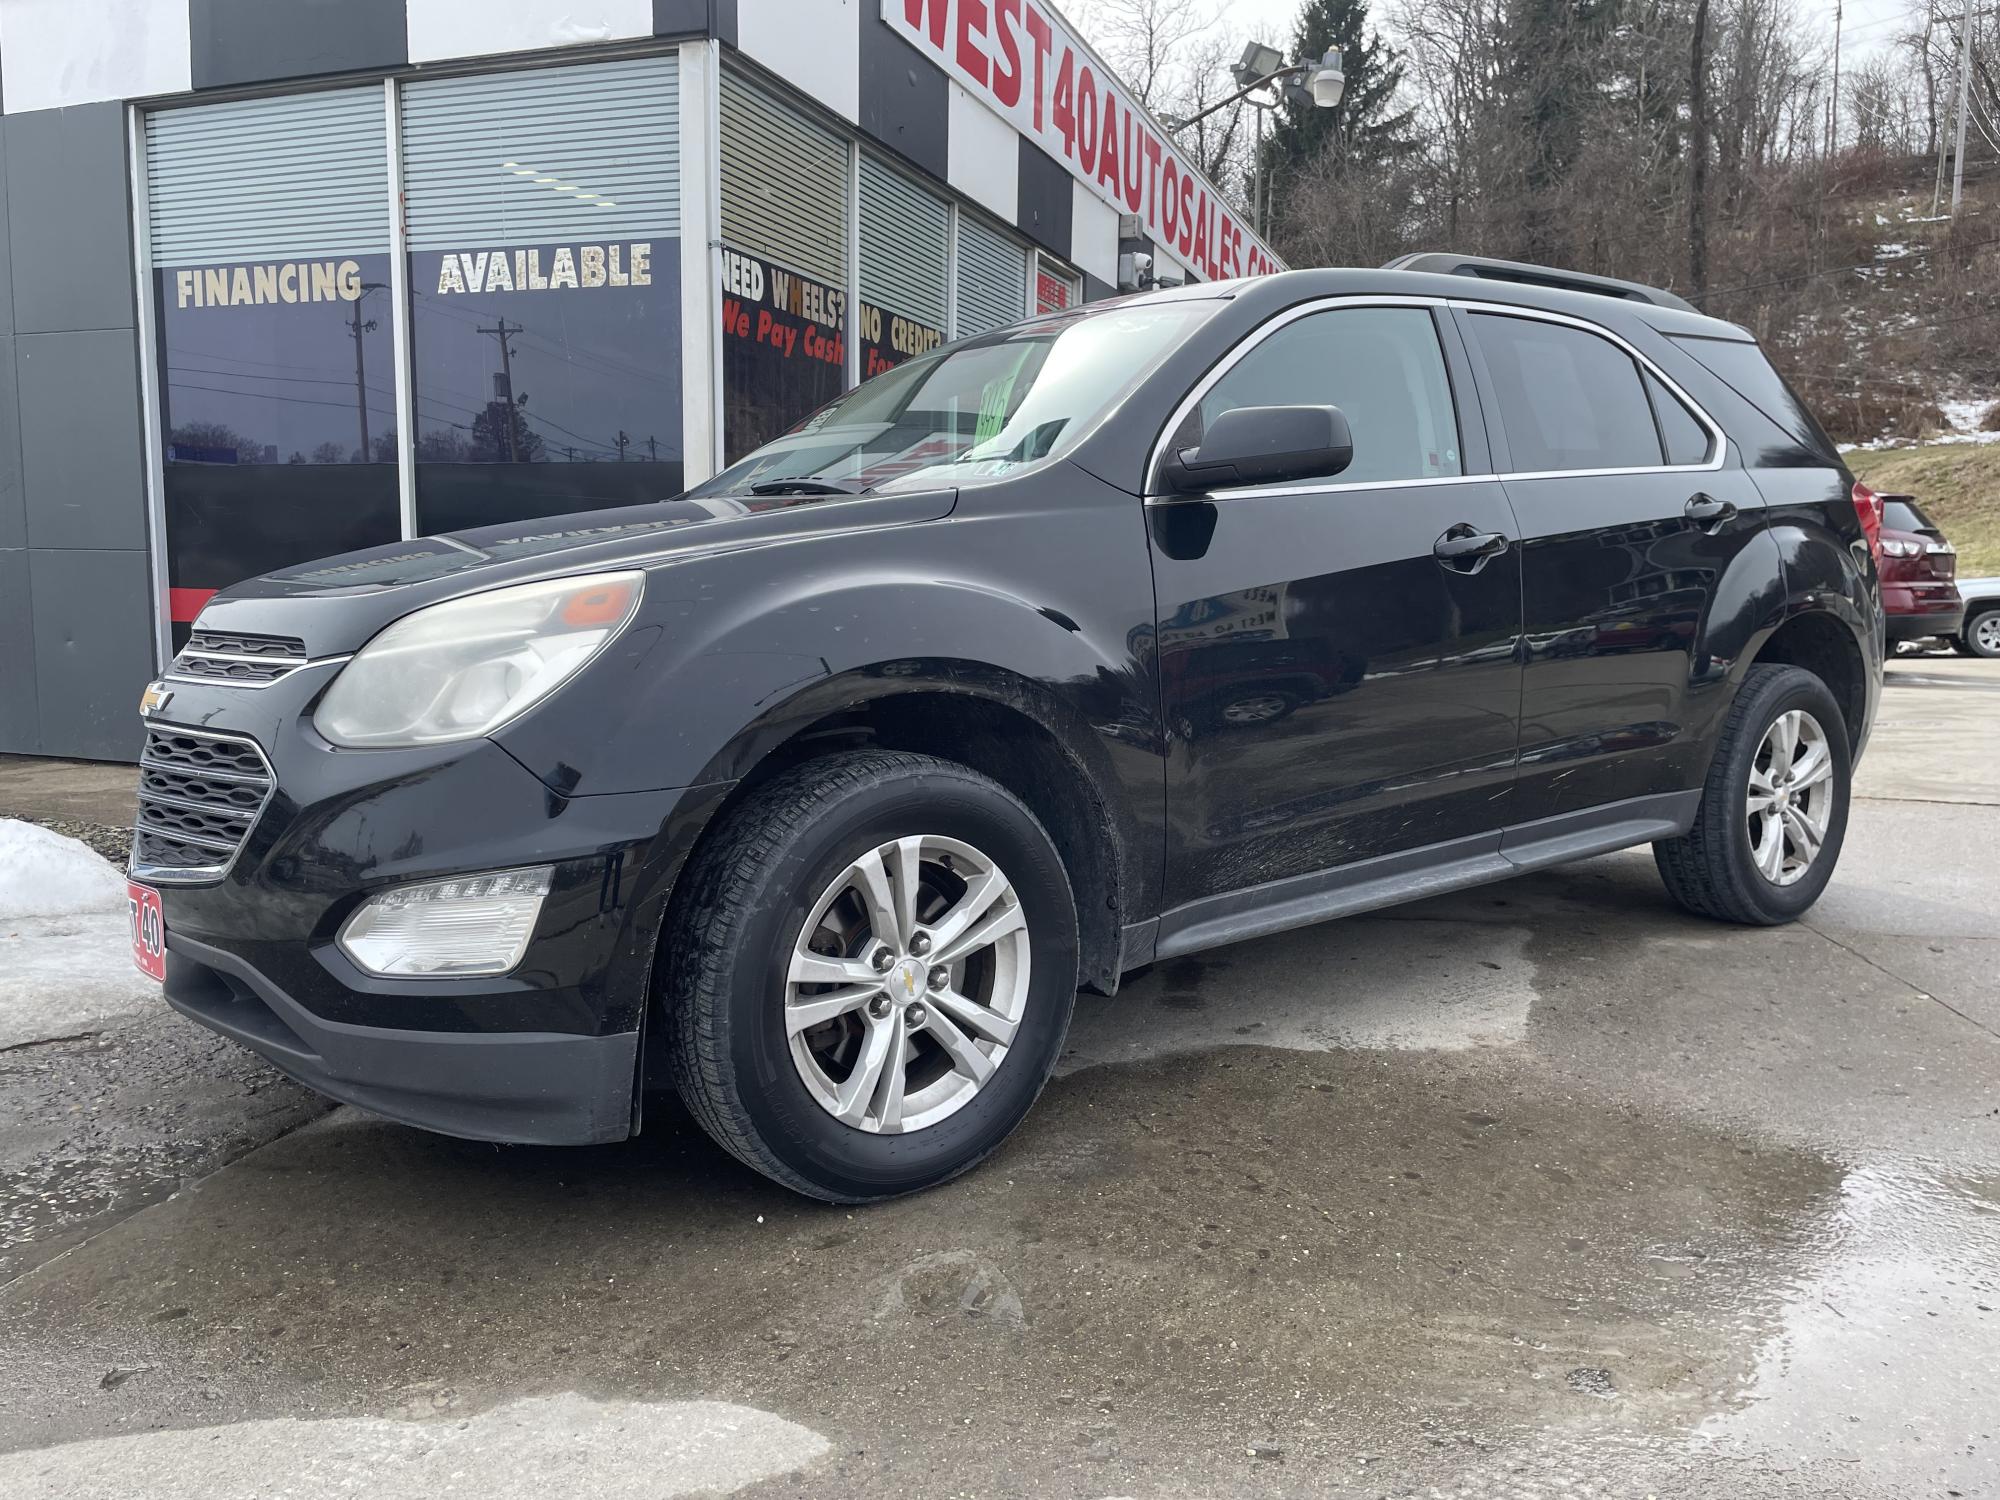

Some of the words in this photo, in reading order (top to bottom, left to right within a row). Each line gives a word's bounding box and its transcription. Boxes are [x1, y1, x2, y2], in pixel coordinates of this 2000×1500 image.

[176, 260, 361, 308] FINANCING
[437, 243, 652, 295] AVAILABLE
[721, 249, 764, 302] NEED
[771, 268, 846, 332] WHEELS?
[723, 299, 750, 337] We
[757, 309, 797, 358] Pay
[804, 325, 845, 366] Cash
[860, 303, 882, 344] NO
[141, 902, 161, 958] 40
